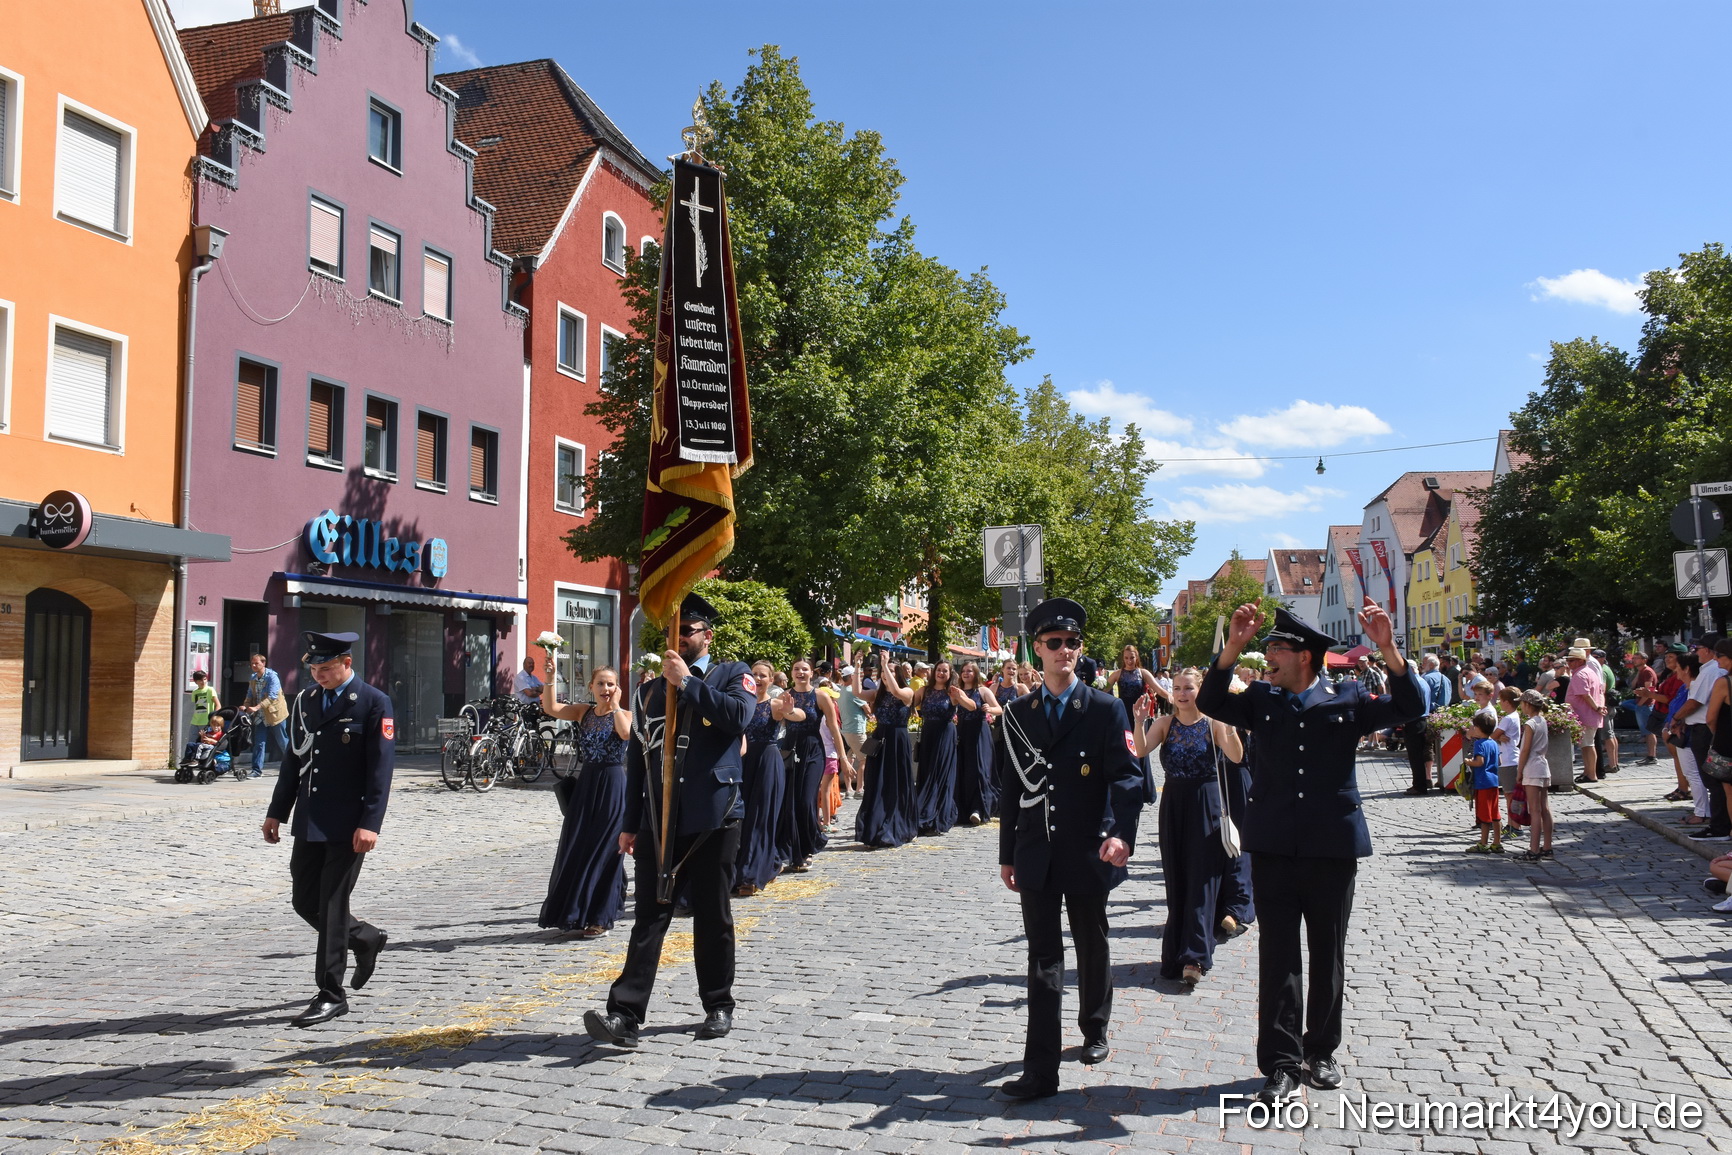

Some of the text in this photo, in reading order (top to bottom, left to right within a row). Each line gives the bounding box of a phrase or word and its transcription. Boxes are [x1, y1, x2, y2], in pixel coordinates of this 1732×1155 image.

[684, 301, 716, 316] Gewidmet
[680, 335, 724, 352] lieben toten
[680, 354, 727, 375] Kameraden
[681, 395, 728, 413] Wappersdorf
[1700, 485, 1721, 494] Ulmer
[306, 509, 421, 575] Eilles
[0, 603, 12, 614] 30
[198, 596, 207, 606] 31
